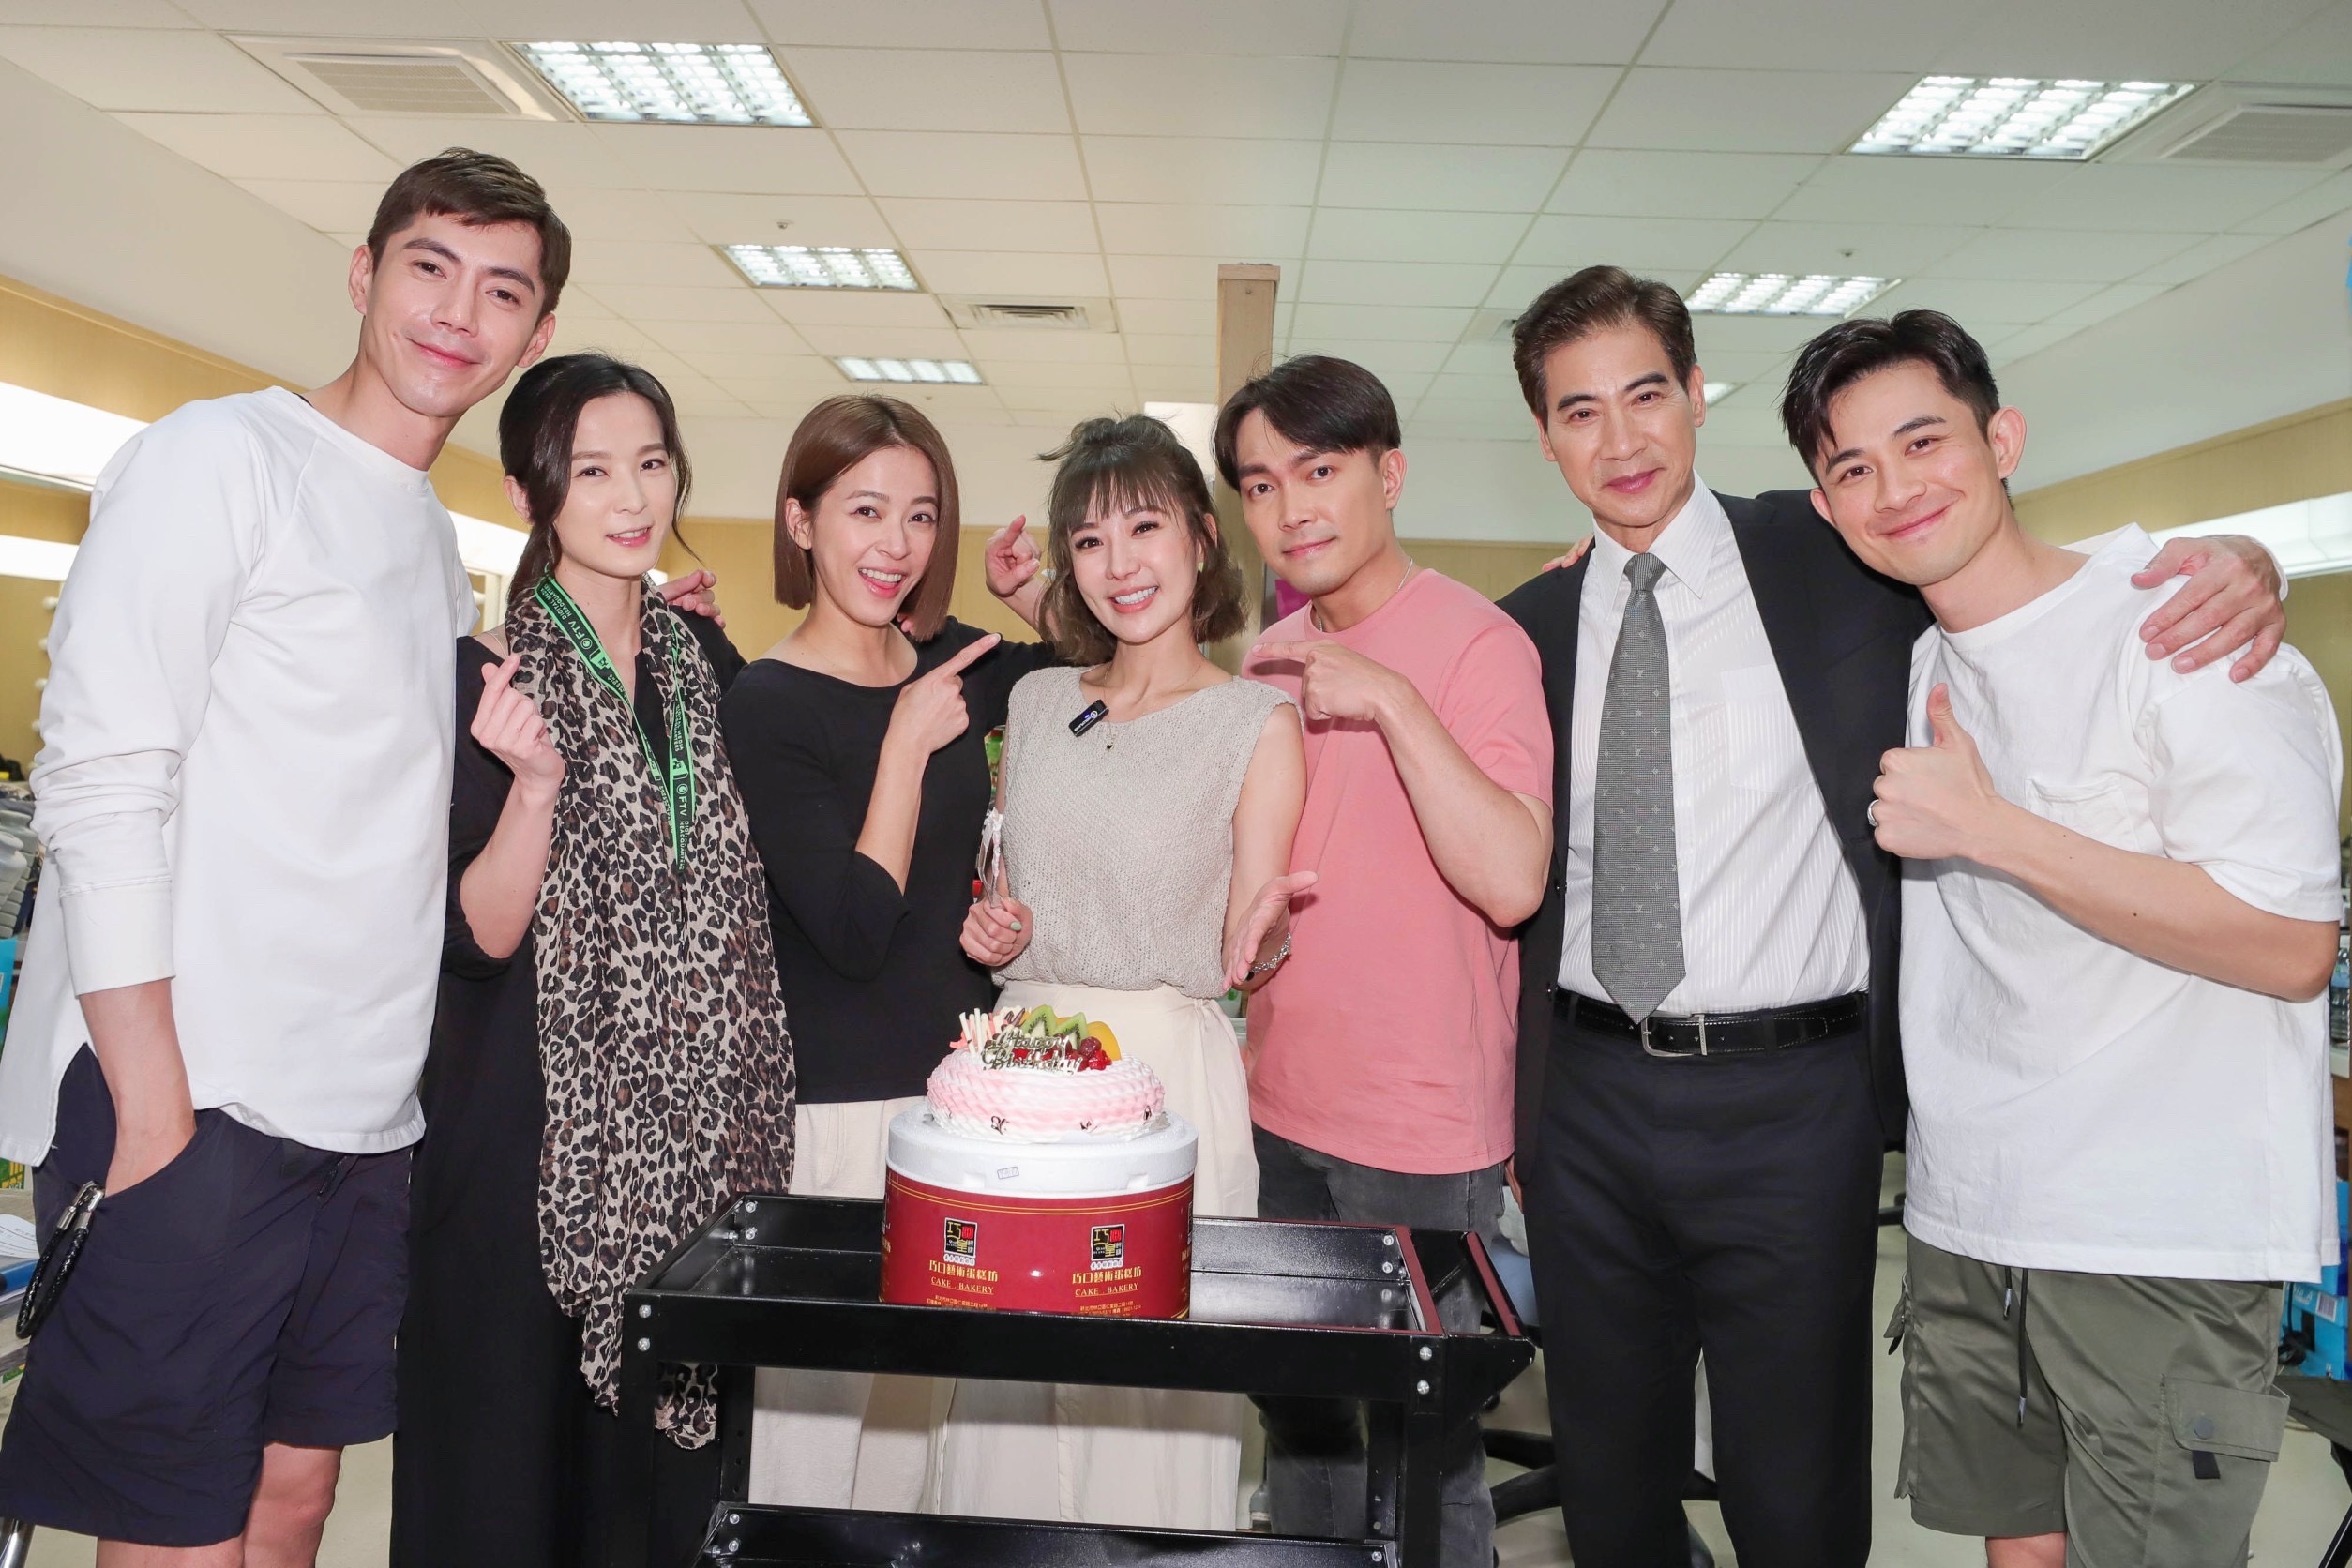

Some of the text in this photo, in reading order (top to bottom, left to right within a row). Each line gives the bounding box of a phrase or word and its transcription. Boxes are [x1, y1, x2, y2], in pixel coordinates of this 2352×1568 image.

[550, 600, 567, 620] DIGITAL
[568, 620, 585, 640] FTV
[679, 796, 687, 816] FTV
[995, 1026, 1070, 1056] Happy
[981, 1045, 1083, 1075] Birthday
[929, 1260, 998, 1282] 巧口藝術蛋糕坊
[1072, 1266, 1142, 1284] 巧口藝術蛋糕坊
[931, 1276, 994, 1294] CAKE BAKERY
[1075, 1282, 1138, 1296] CAKE BAKERY
